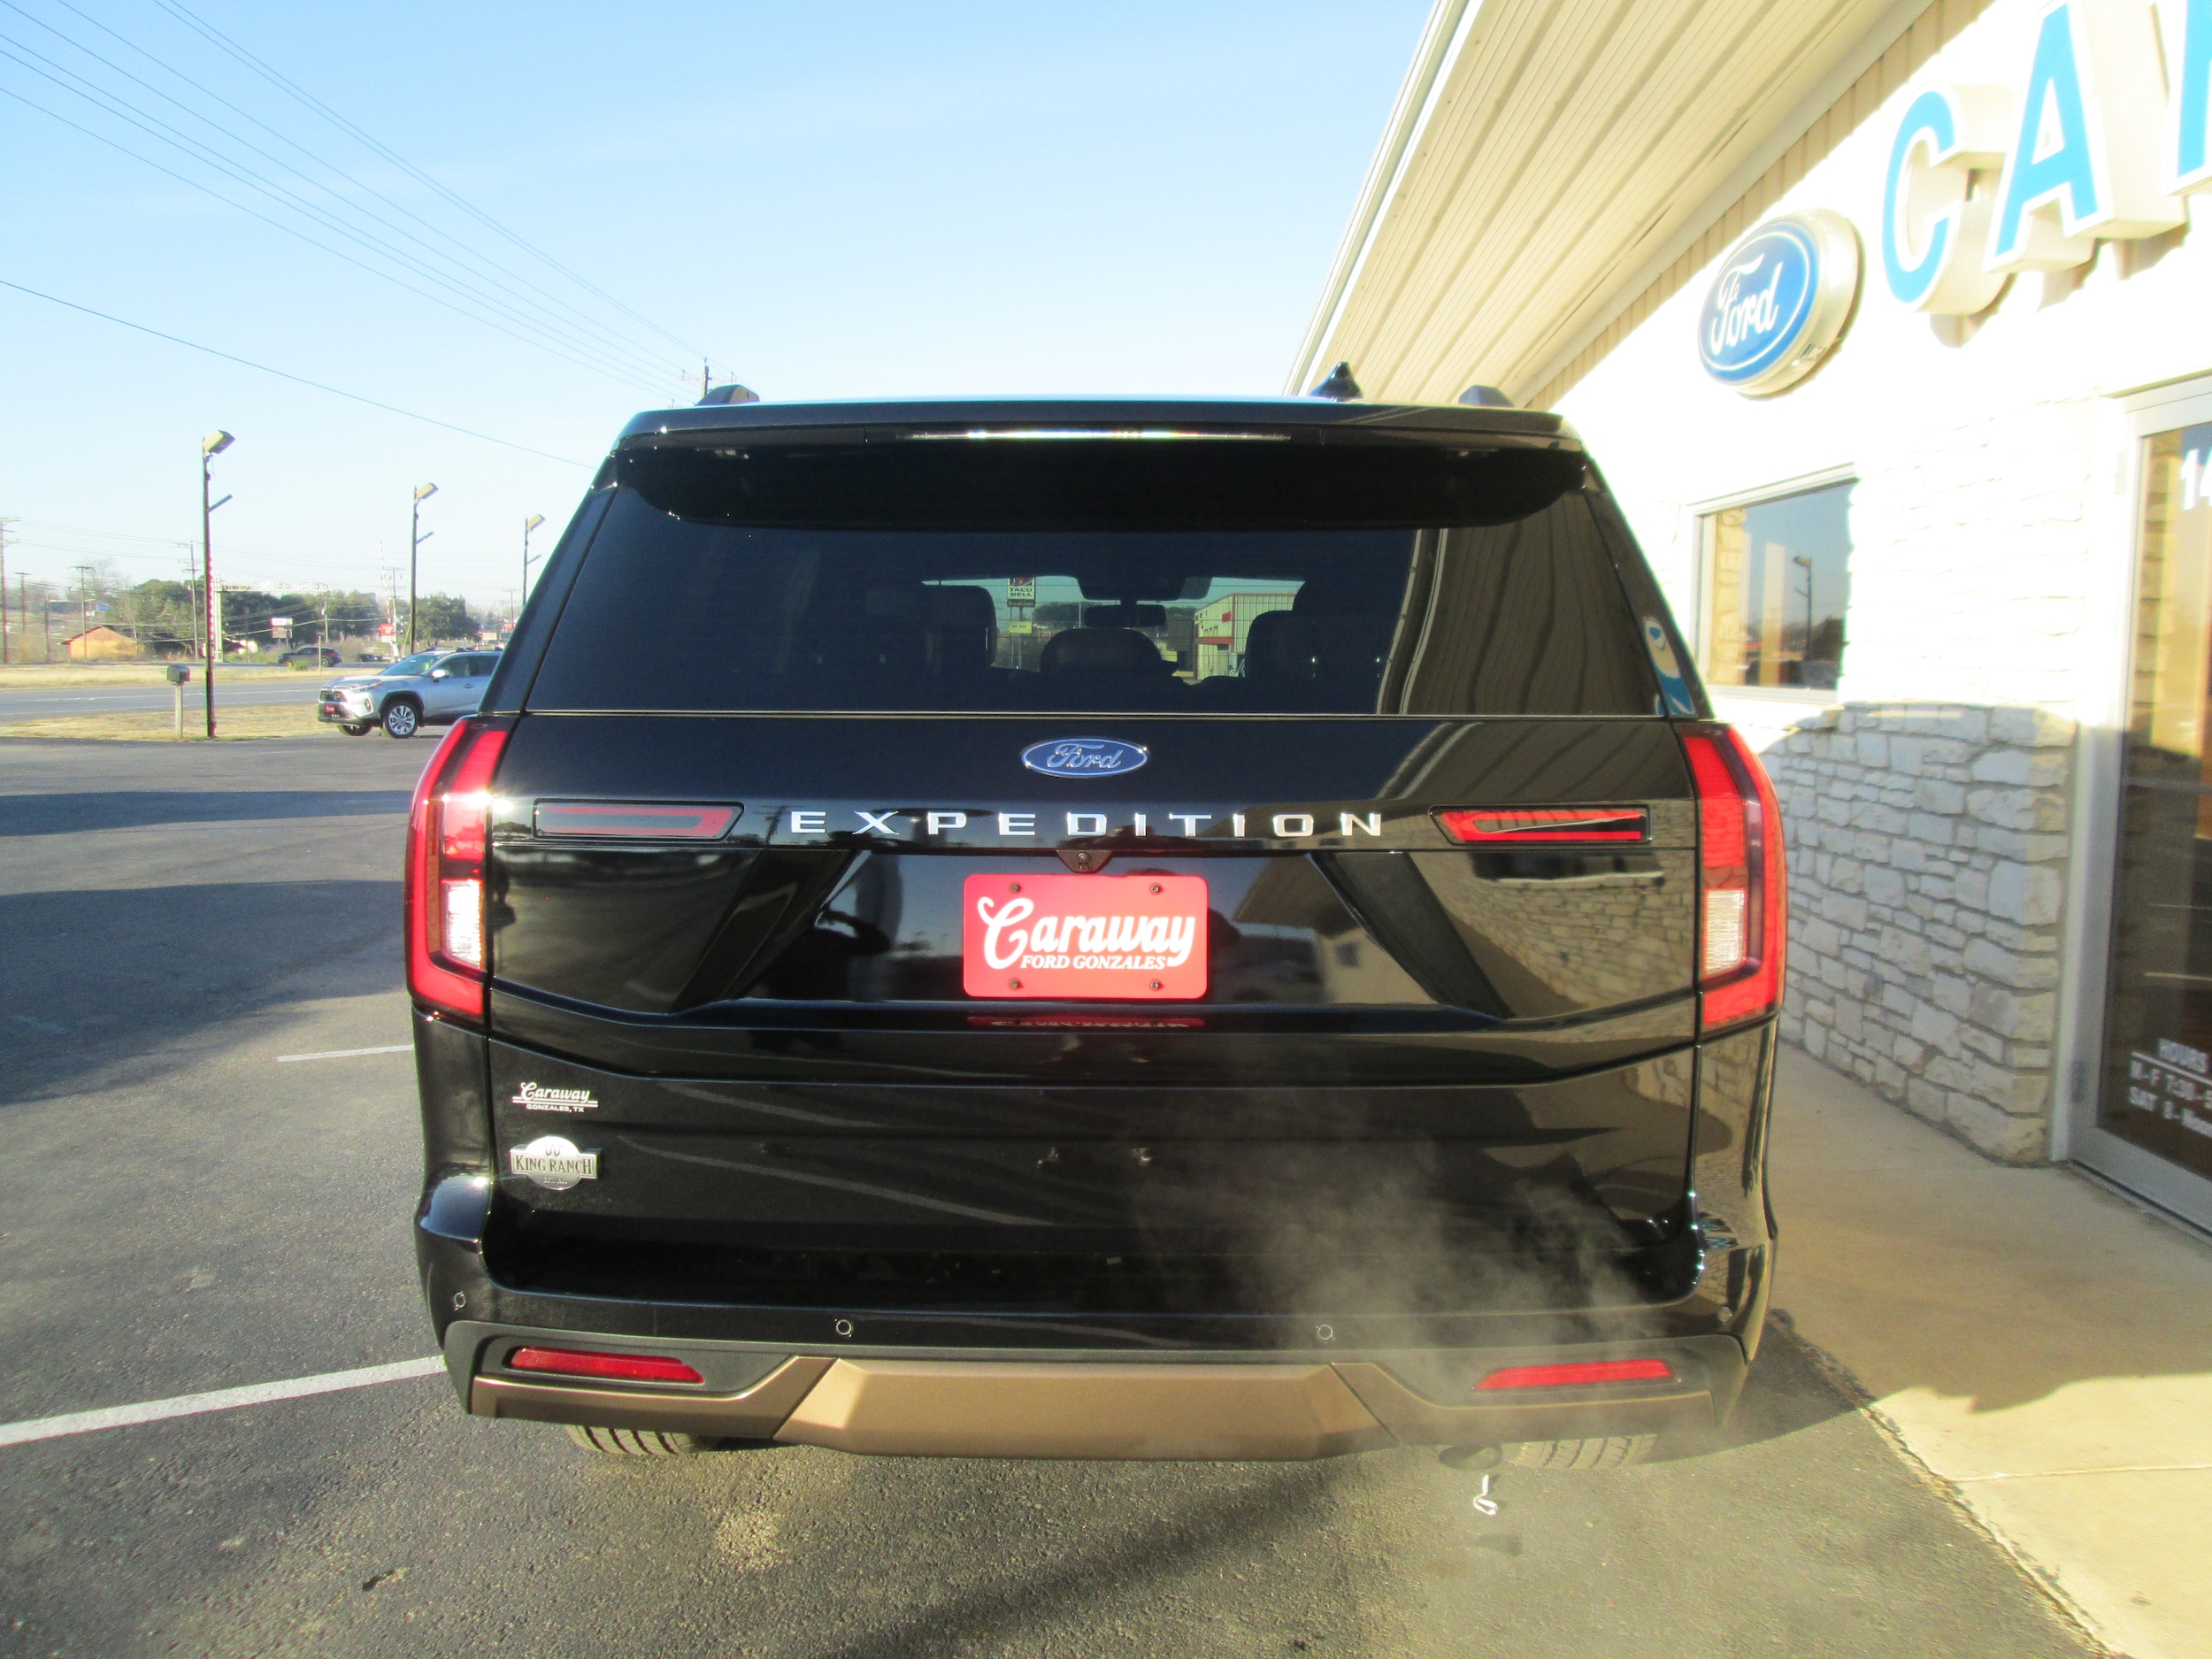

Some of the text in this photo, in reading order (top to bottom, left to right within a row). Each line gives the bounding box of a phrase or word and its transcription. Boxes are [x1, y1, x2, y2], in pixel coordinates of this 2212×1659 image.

[1881, 0, 2212, 303] CA
[1710, 253, 1784, 356] Ford
[1047, 742, 1124, 769] Ford
[791, 810, 1382, 837] EXPEDITION
[977, 896, 1196, 970] Caraway
[1019, 955, 1168, 971] FORD GONZALES
[520, 1081, 590, 1103] Caraway
[526, 1103, 572, 1113] GONZALES,
[515, 1155, 593, 1175] KING RANCH
